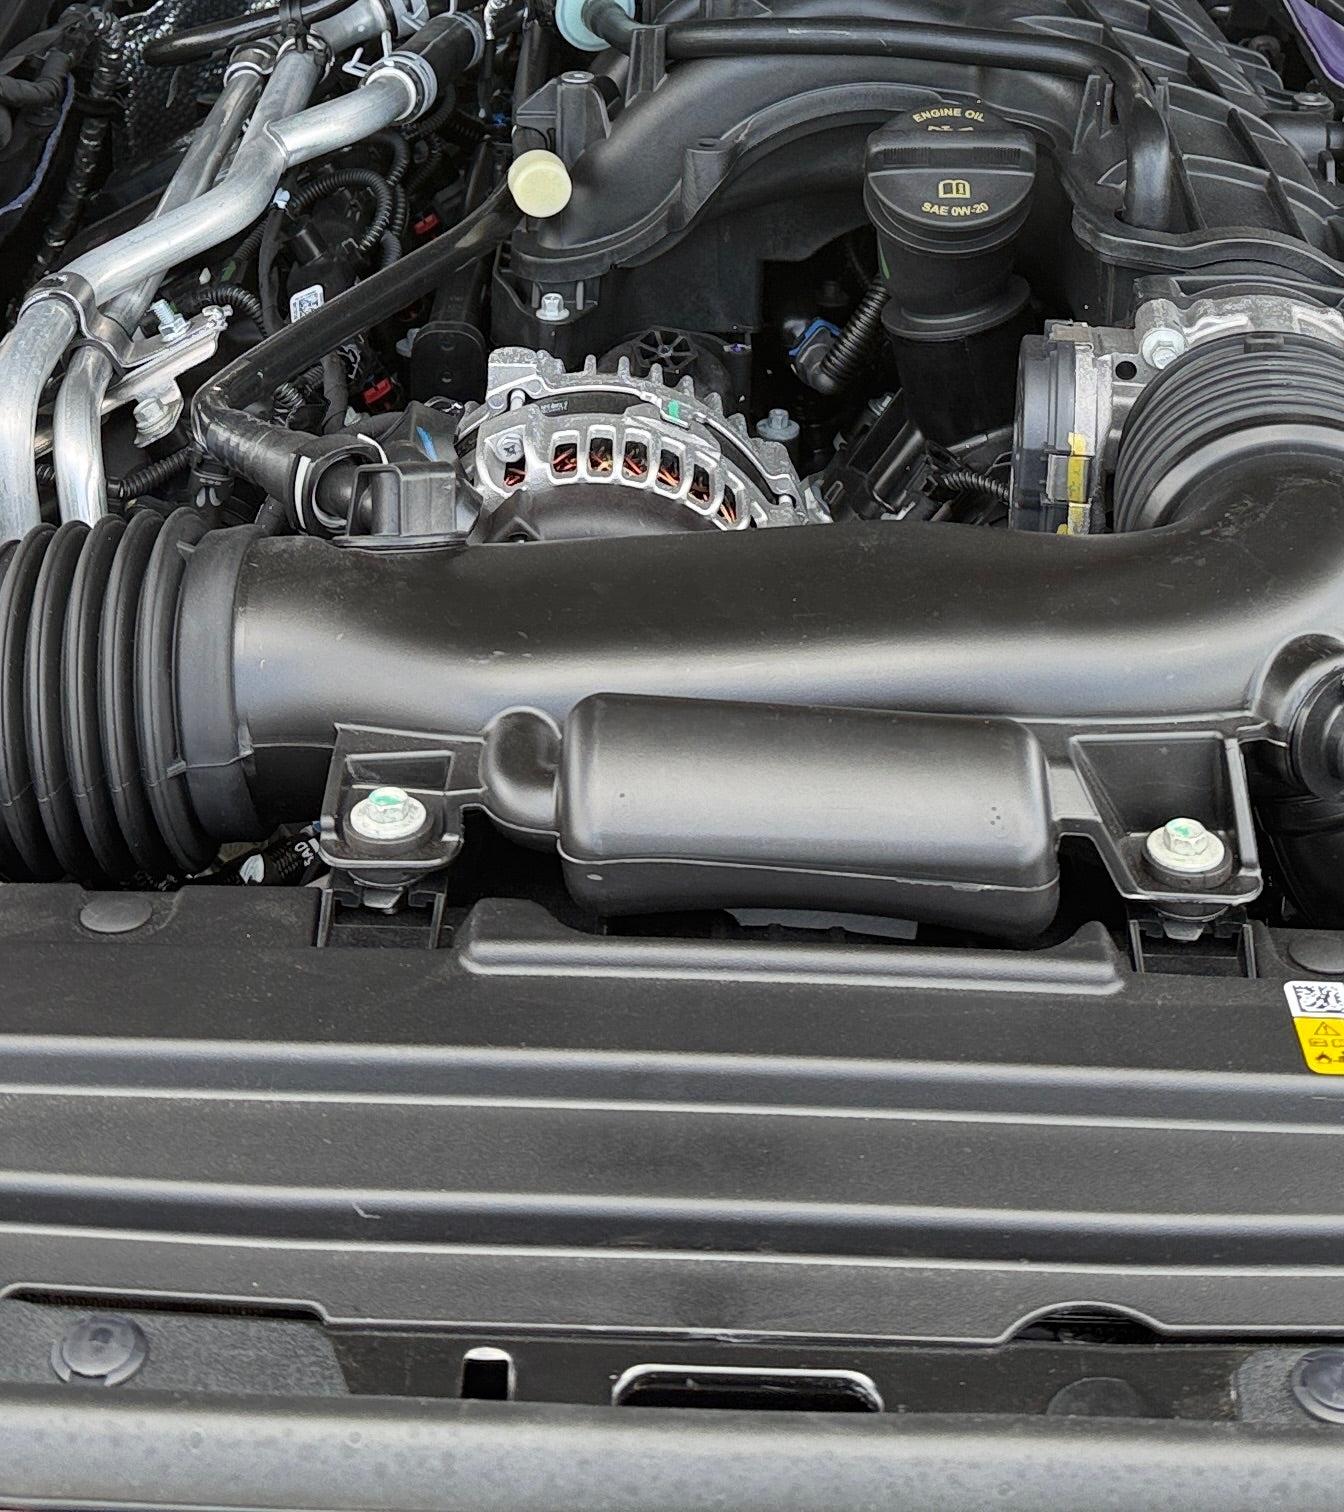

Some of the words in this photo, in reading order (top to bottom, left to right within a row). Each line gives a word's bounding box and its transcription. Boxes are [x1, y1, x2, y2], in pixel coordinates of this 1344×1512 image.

[912, 108, 962, 123] ENGINE
[964, 109, 985, 123] OIL
[921, 202, 949, 216] SAE
[951, 202, 989, 216] 0W-20
